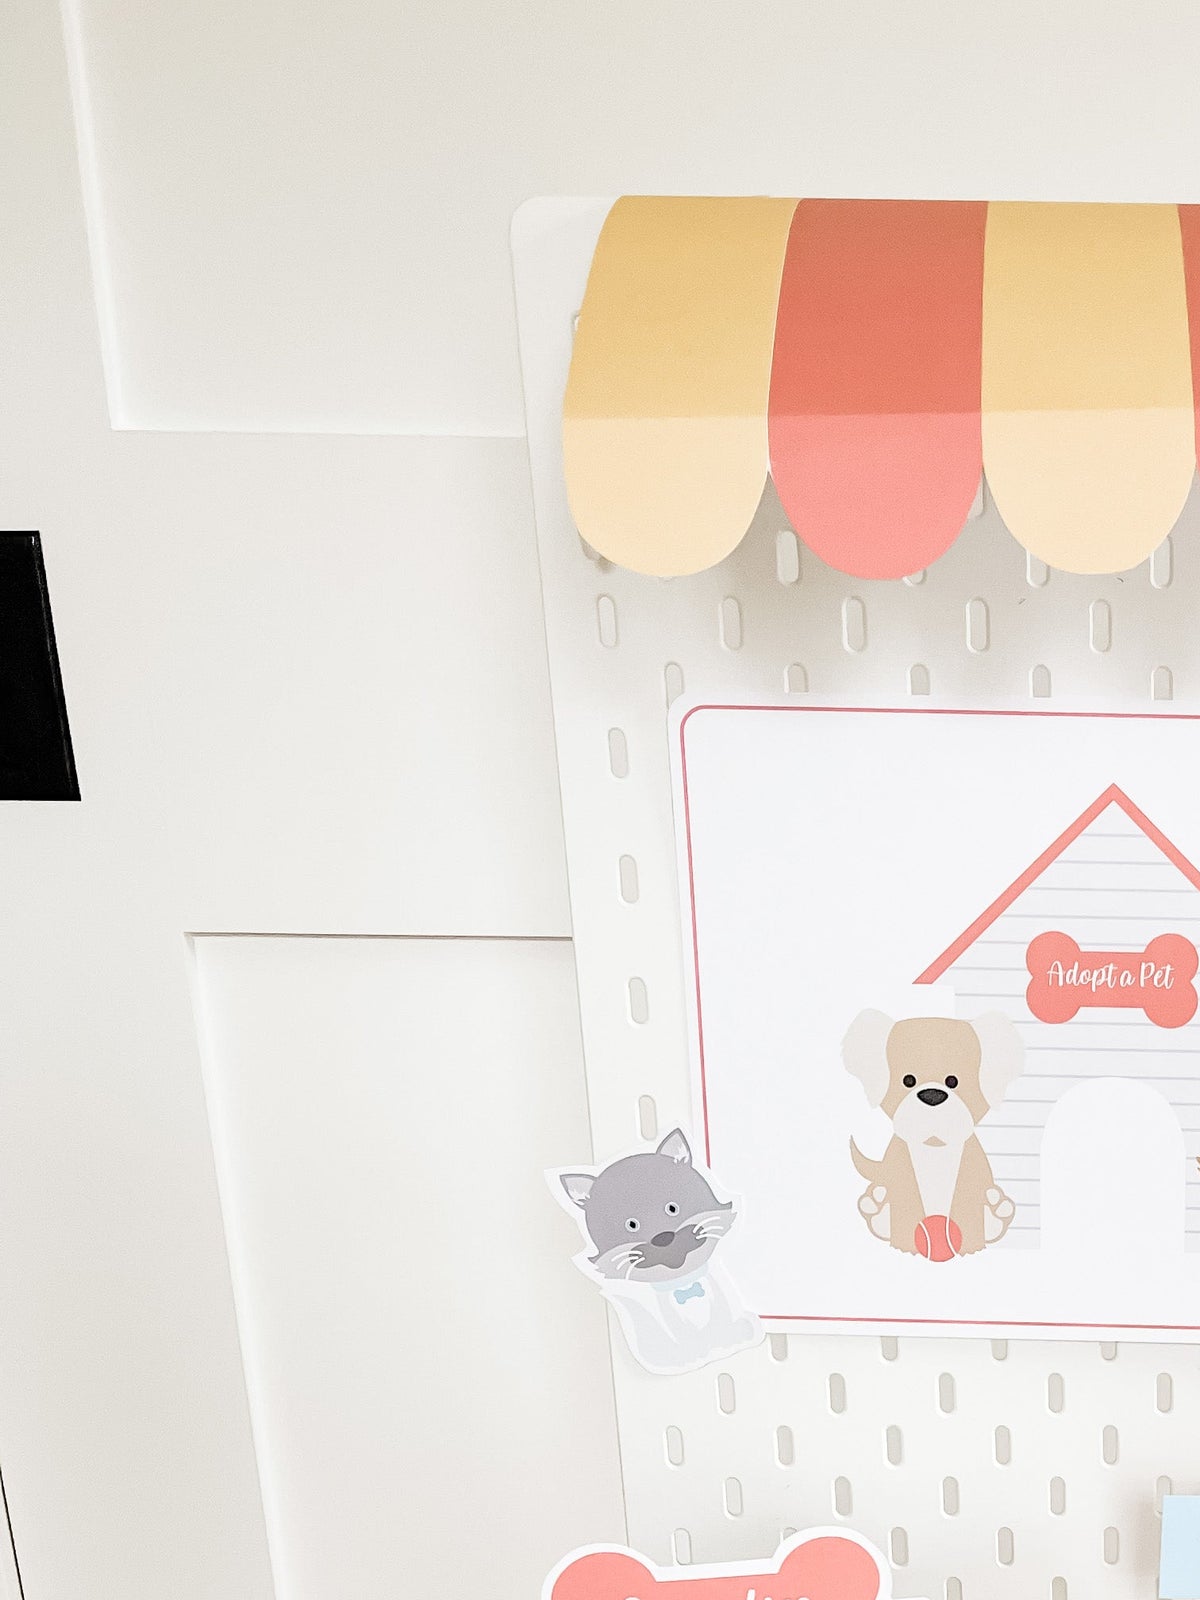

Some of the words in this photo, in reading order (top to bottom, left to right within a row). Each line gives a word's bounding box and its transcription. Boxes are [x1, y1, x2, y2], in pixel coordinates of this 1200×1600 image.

[1047, 960, 1118, 992] Adopt
[1120, 970, 1135, 988] a
[1139, 961, 1175, 990] Pet
